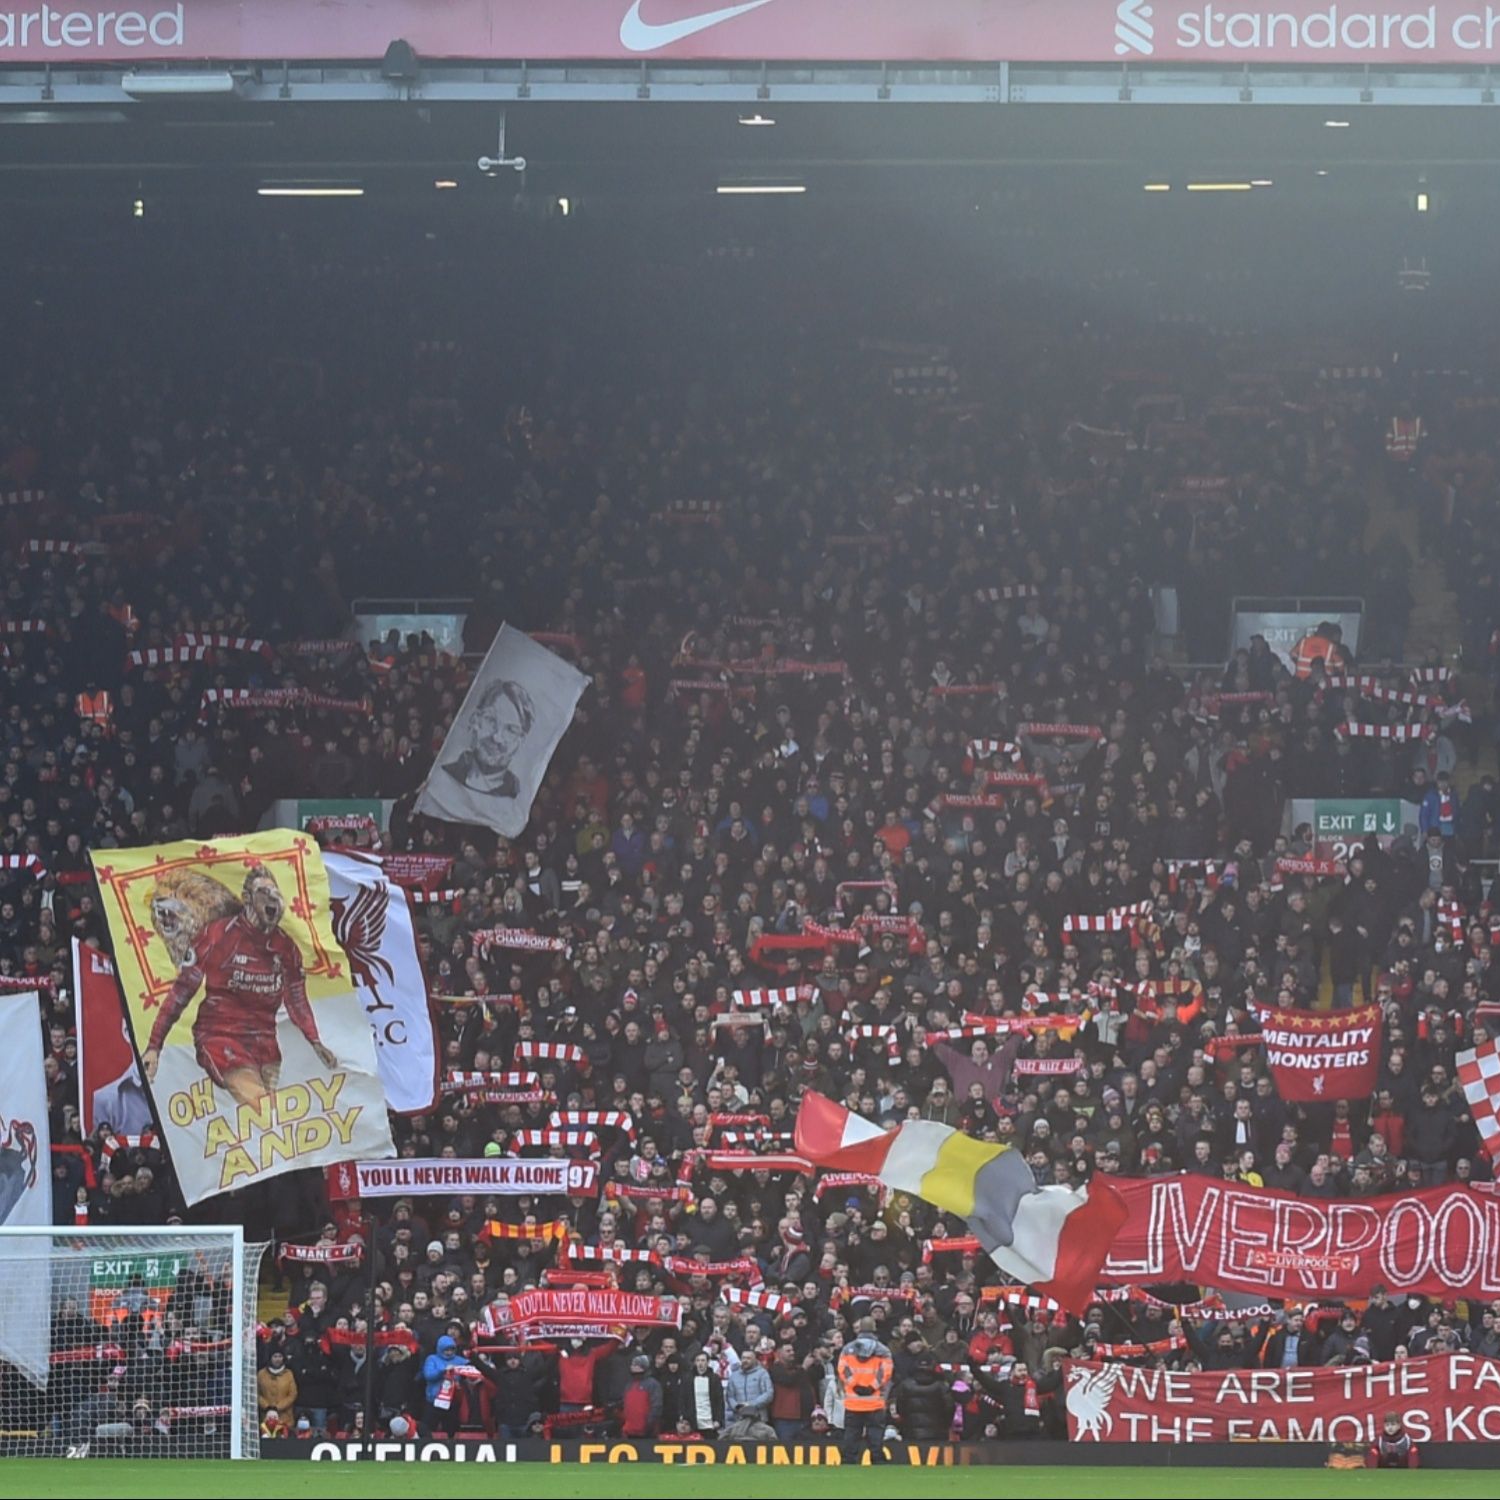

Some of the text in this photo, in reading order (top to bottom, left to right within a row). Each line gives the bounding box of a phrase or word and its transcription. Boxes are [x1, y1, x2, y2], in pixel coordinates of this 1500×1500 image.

[1175, 3, 1436, 50] standard
[1263, 628, 1299, 642] EXIT
[1318, 815, 1356, 830] EXIT
[495, 935, 549, 949] CHAMPIONS
[37, 976, 49, 986] FC
[232, 971, 275, 984] Standard
[1262, 1028, 1373, 1048] MENTALITY
[1039, 1060, 1060, 1072] ALLEZ
[1267, 1049, 1370, 1069] MONSTERS
[168, 1075, 216, 1127] OH
[203, 1073, 347, 1159] ANDY
[219, 1106, 364, 1190] ANDY
[413, 1166, 463, 1186] NEVER
[465, 1166, 512, 1186] WALK
[513, 1166, 563, 1186] ALONE
[569, 1165, 595, 1189] 97
[93, 1261, 133, 1276] EXIT
[689, 1259, 752, 1271] LIVERPOOL
[1275, 1255, 1330, 1268] LIVERPOOL
[552, 1291, 586, 1313] NEVER
[587, 1293, 619, 1314] WALK
[619, 1295, 655, 1316] ALONE
[1116, 1370, 1194, 1404] WE
[1215, 1371, 1315, 1404] ARE
[1333, 1360, 1429, 1401] THE
[1120, 1412, 1213, 1443] THE
[310, 1442, 518, 1463] OFFICIAL
[550, 1444, 640, 1465] LFC
